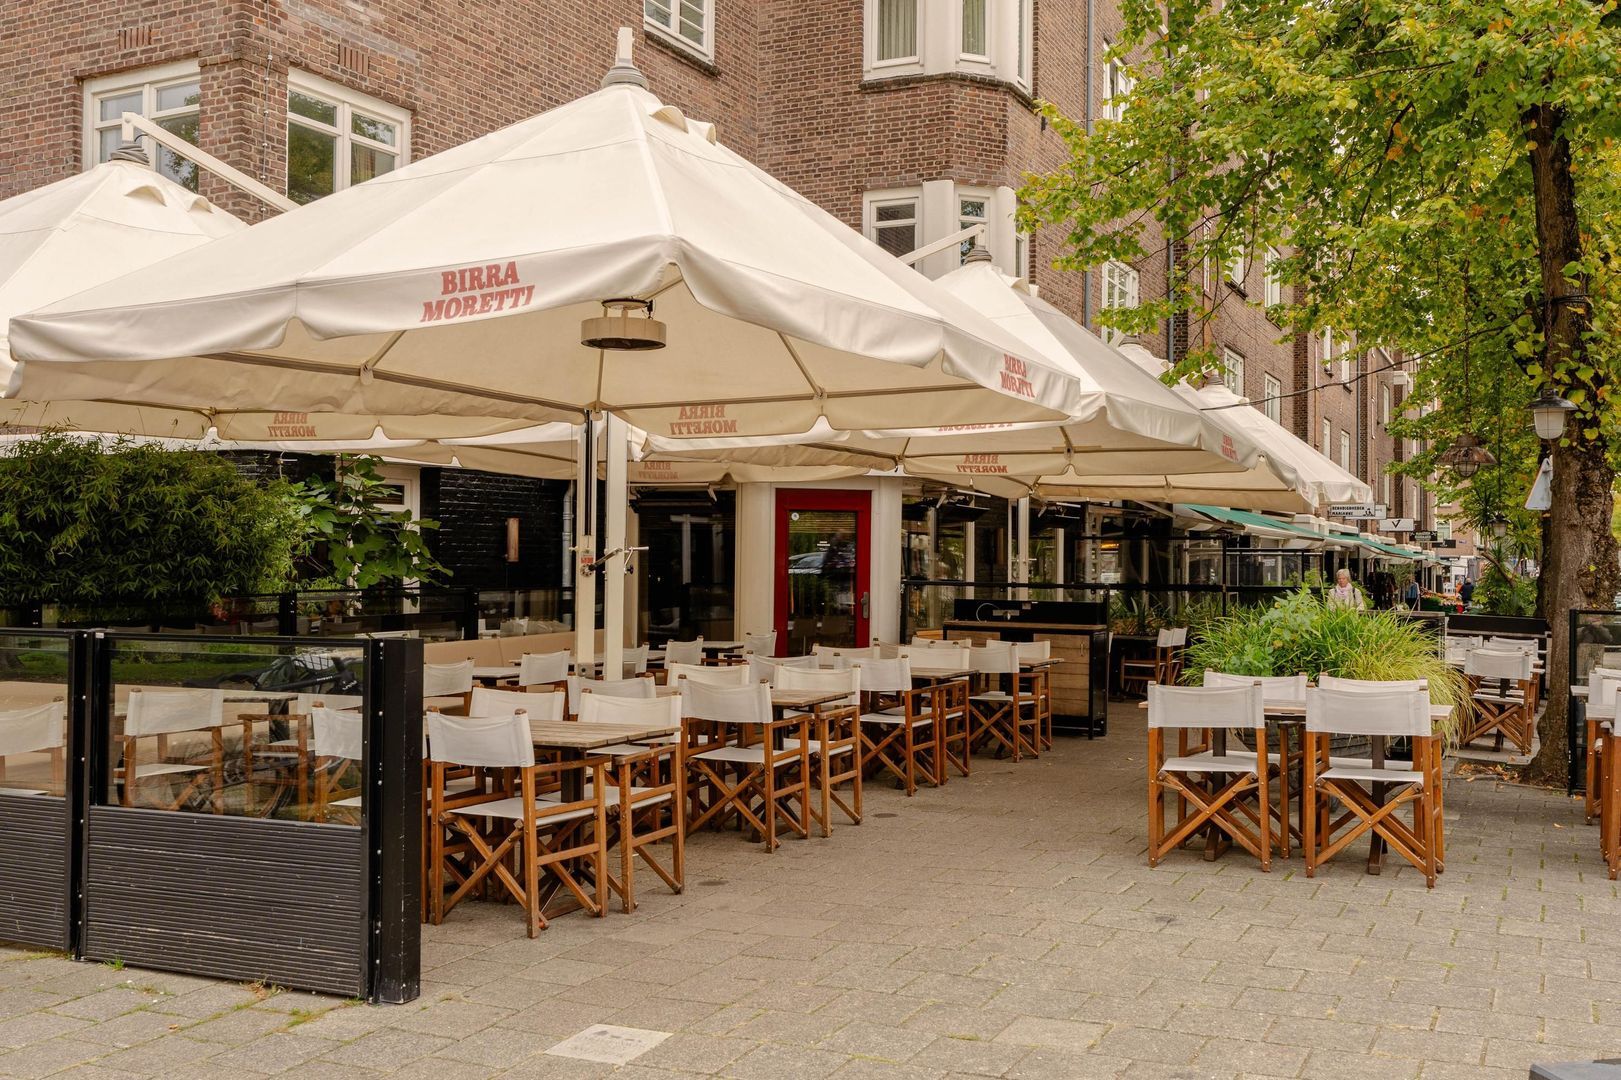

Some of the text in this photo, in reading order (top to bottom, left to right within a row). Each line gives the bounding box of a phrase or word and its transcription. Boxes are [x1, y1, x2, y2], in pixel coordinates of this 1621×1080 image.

[441, 261, 520, 295] BIRRA
[420, 285, 535, 322] MORETTI
[1003, 353, 1027, 377] BIRRA
